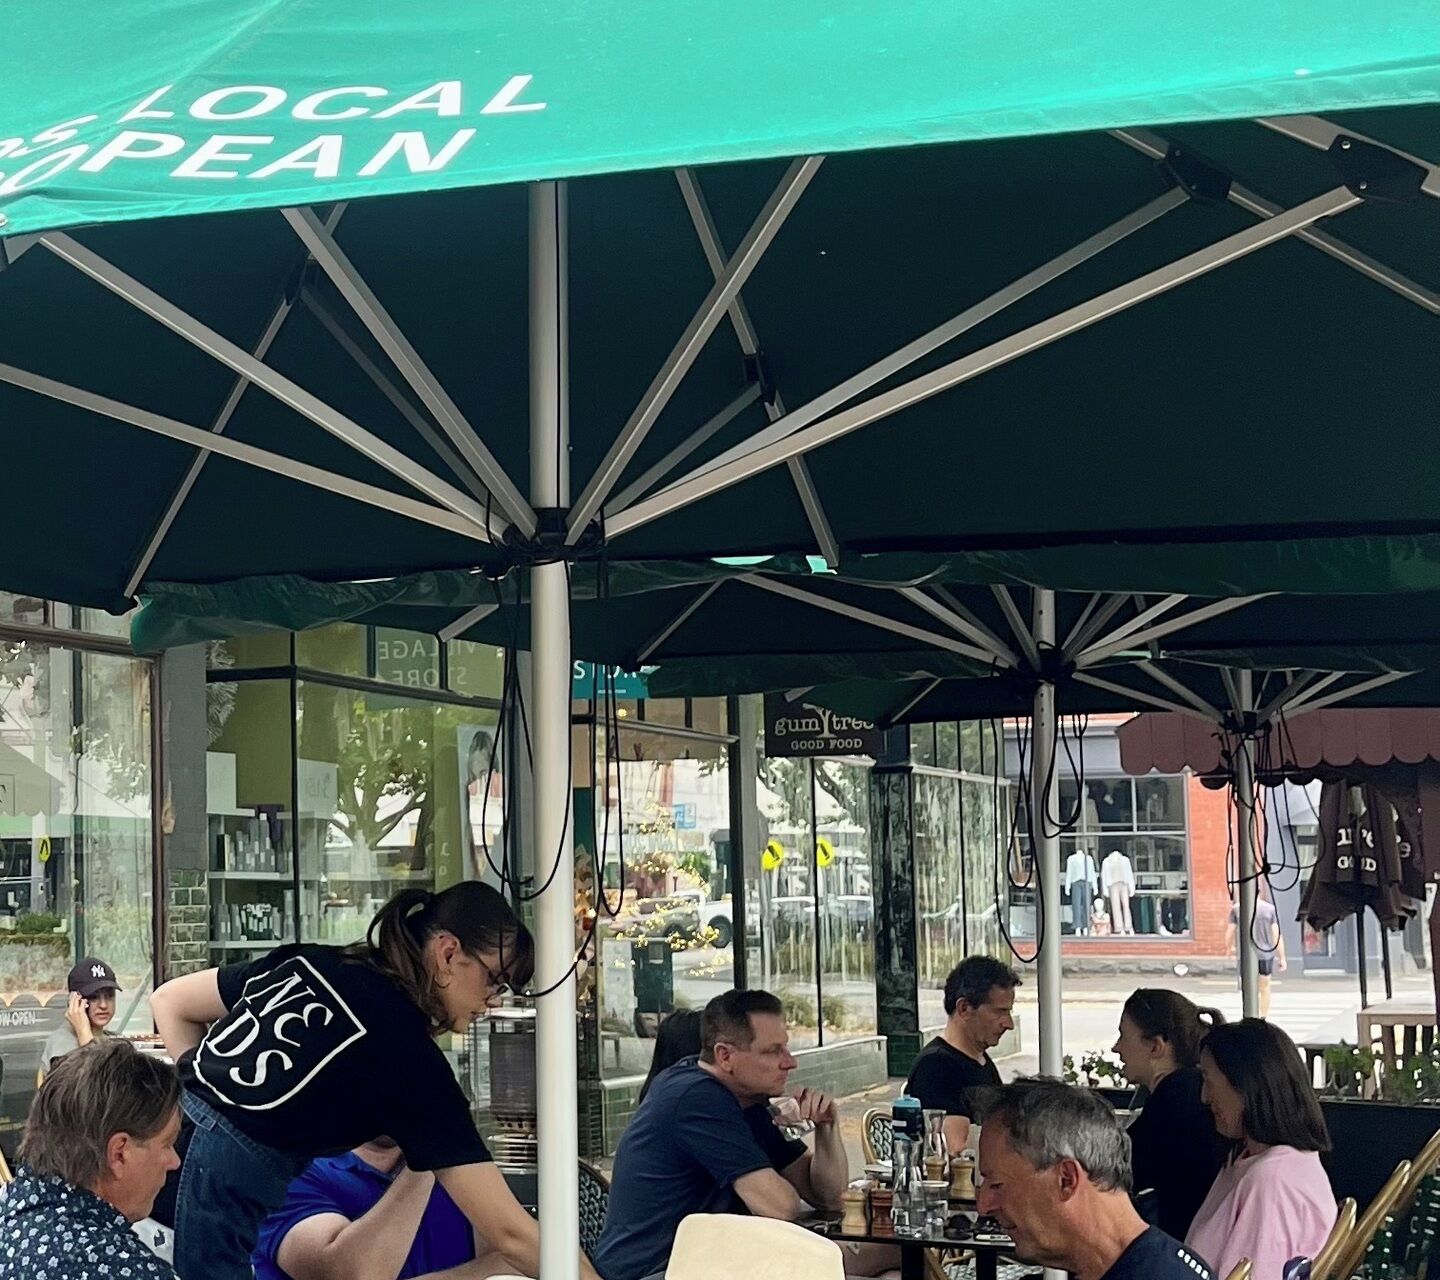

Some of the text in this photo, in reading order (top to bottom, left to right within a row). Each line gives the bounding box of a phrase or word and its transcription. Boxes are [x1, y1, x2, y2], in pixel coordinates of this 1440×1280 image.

[116, 74, 548, 124] LOCAL
[774, 717, 820, 736] gum
[791, 738, 863, 751] GOOD FOOD
[11, 1010, 36, 1026] OPEN
